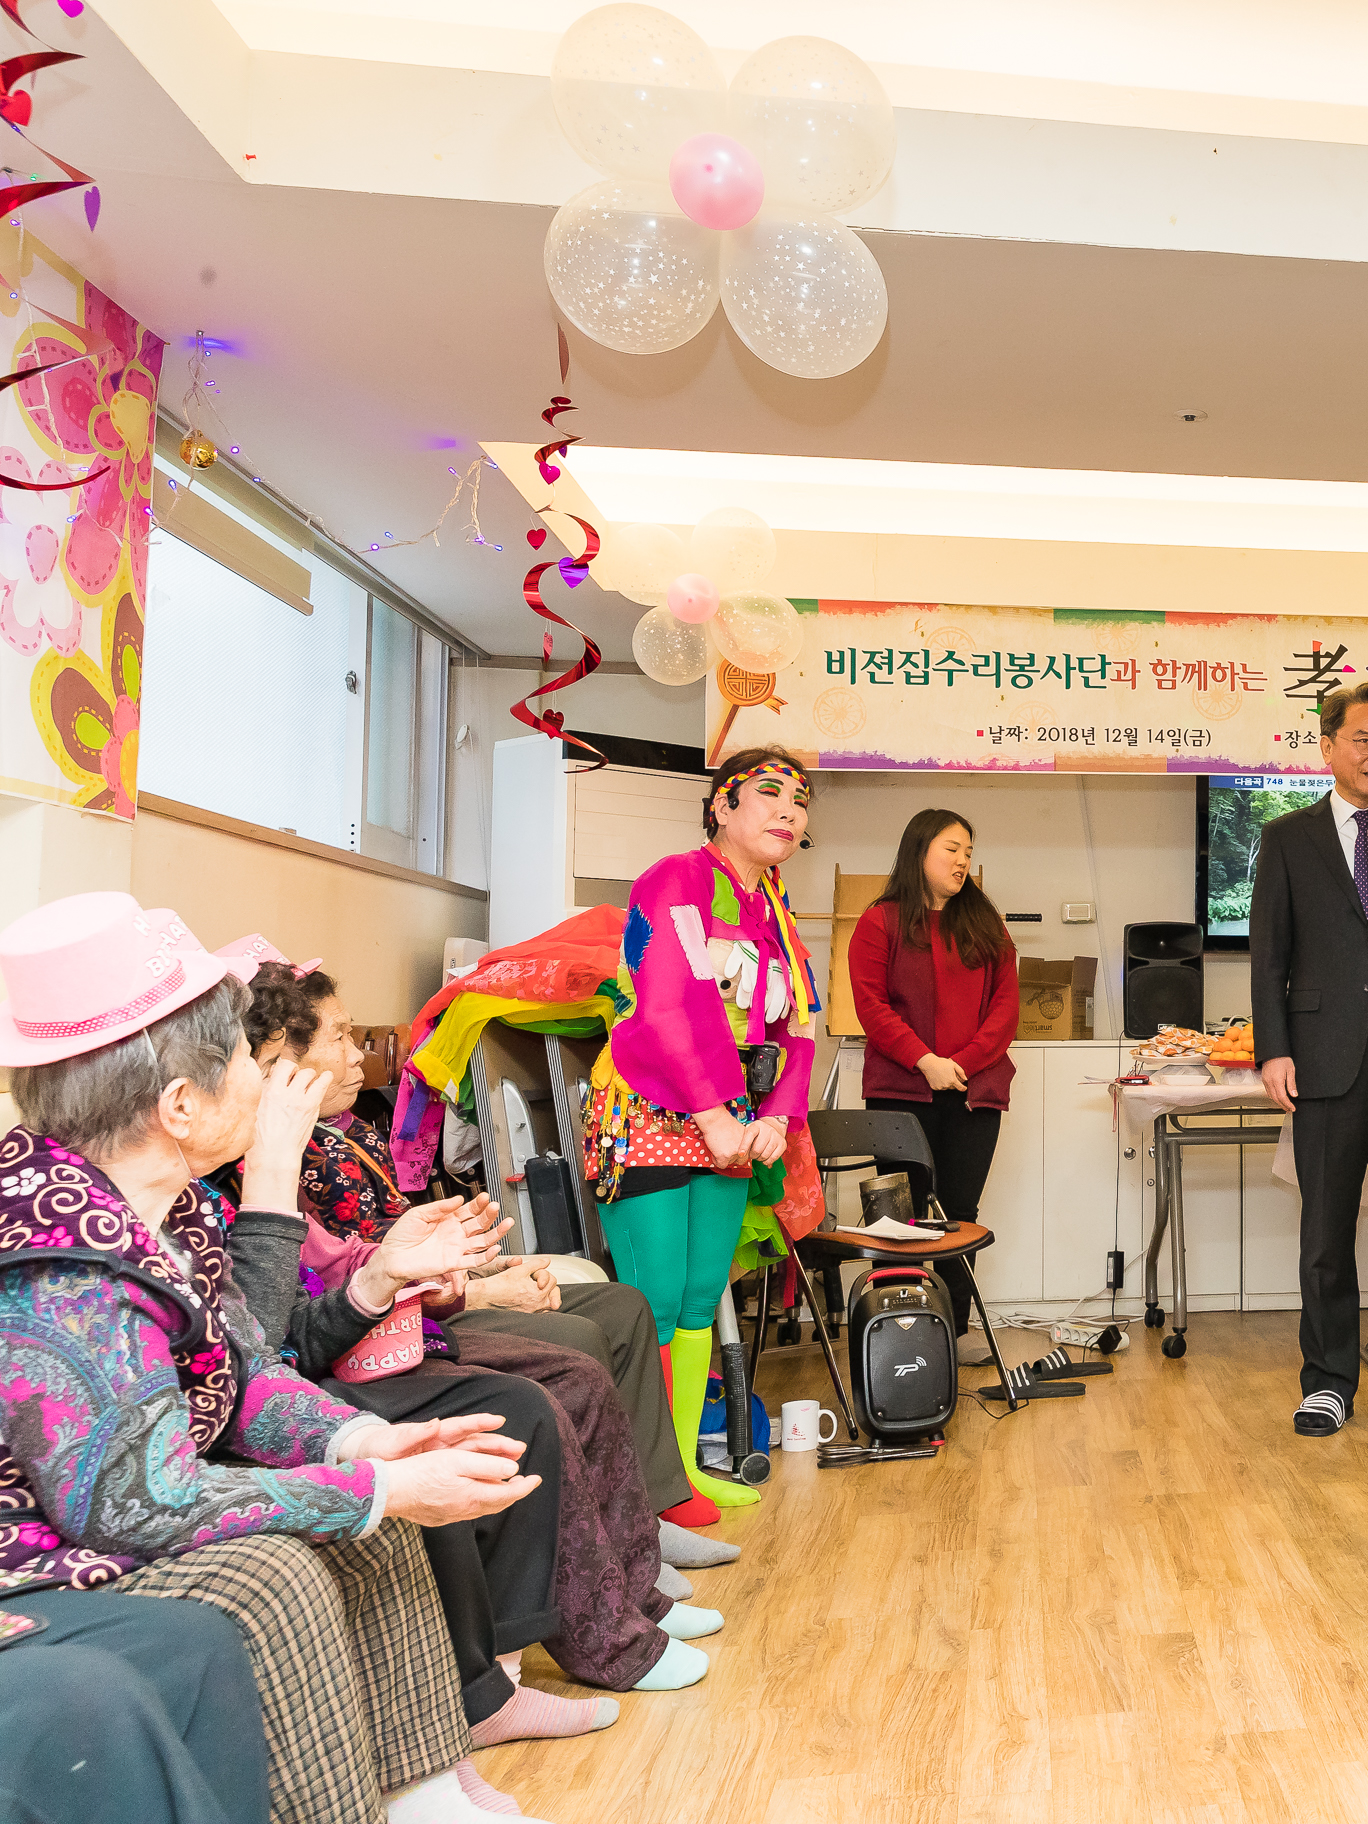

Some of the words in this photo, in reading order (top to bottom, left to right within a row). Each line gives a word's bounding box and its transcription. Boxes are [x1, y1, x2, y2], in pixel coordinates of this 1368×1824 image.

[823, 647, 1141, 690] 비젼집수리봉사단과
[1148, 658, 1268, 692] 함께하는
[988, 725, 1029, 744] 날짜:
[1037, 726, 1096, 746] 2018년
[1104, 727, 1139, 747] 12월
[1147, 728, 1212, 747] 14일(금)
[1234, 777, 1262, 786] 다음곡
[1266, 777, 1284, 785] 748
[1289, 779, 1334, 787] 눈물젖은두
[363, 1311, 421, 1340] BIRTH
[347, 1340, 420, 1371] HAPPY
